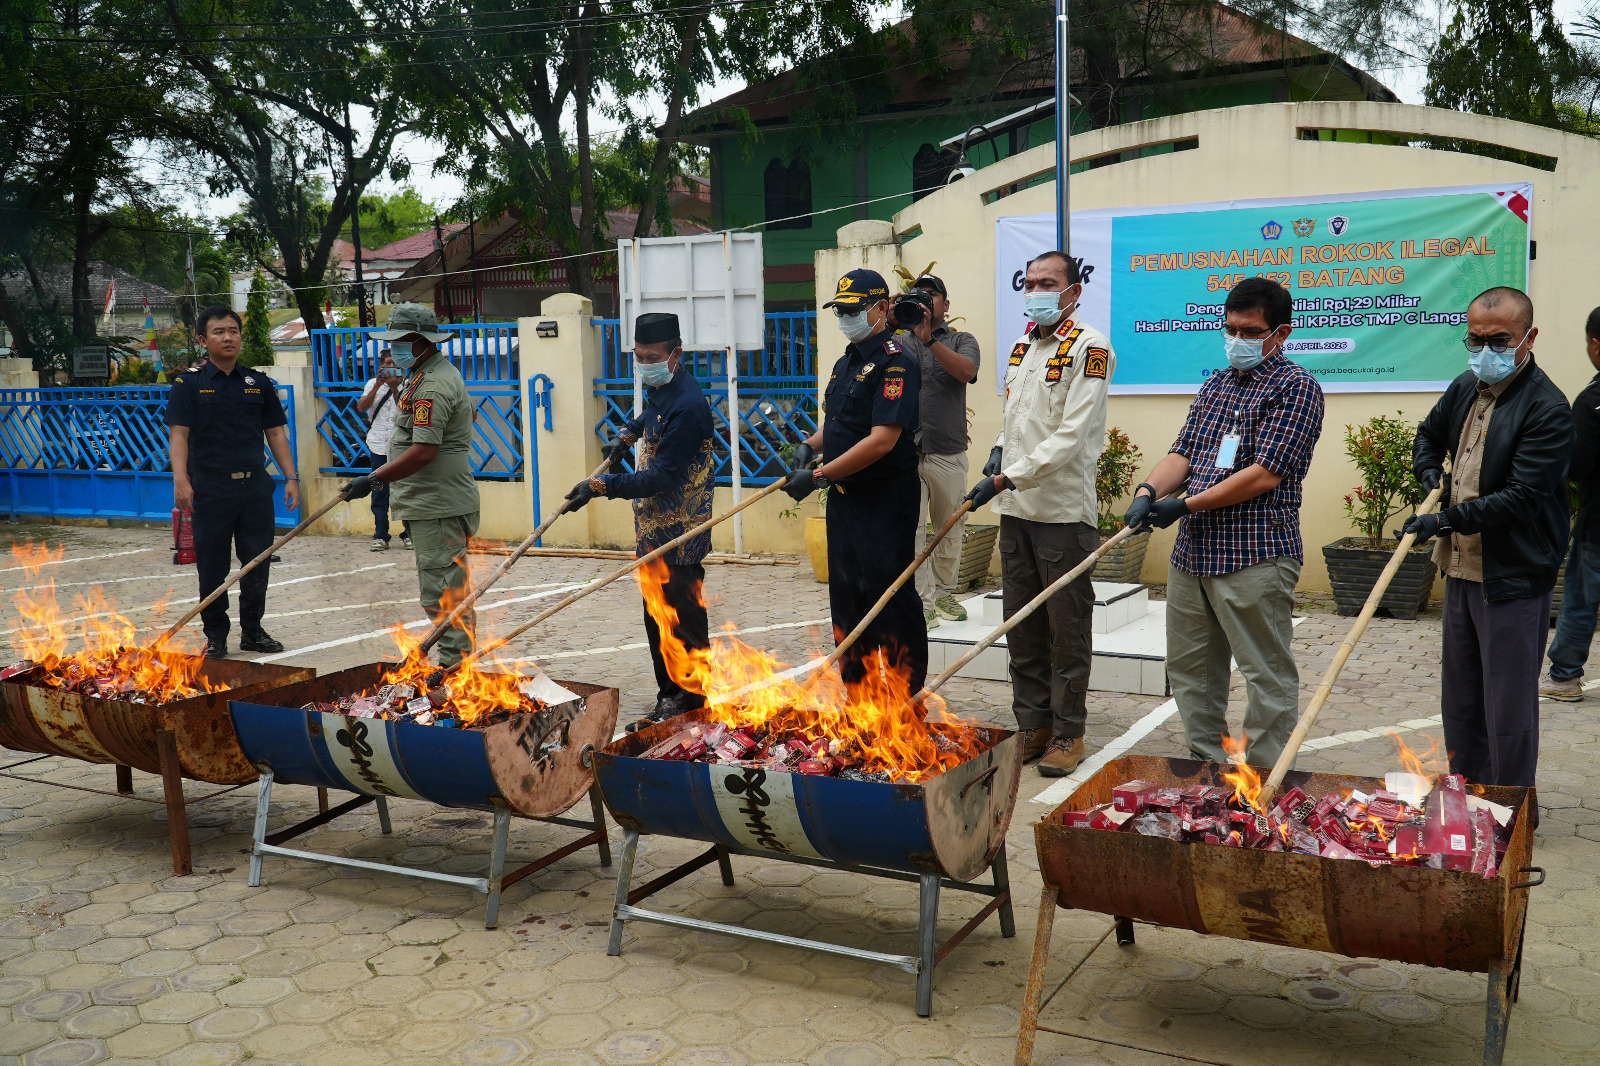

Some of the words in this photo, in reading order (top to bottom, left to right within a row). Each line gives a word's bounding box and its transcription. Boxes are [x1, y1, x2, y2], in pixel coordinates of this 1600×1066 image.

[1130, 246, 1293, 272] PEMUSNAHAN
[1300, 240, 1395, 265] ROKOK
[1400, 236, 1496, 260] ILEGAL
[1298, 266, 1405, 289] BATANG
[1186, 303, 1226, 317] Deng
[1323, 296, 1373, 313] Rp1,29
[1376, 294, 1421, 309] Miliar
[1135, 319, 1169, 333] Hasil
[1306, 314, 1364, 329] KPPBC
[1365, 313, 1402, 327] TMP
[1404, 312, 1418, 325] C
[1420, 311, 1468, 327] Langs
[1287, 342, 1294, 351] 9
[1294, 342, 1323, 351] APRIL
[1323, 341, 1348, 350] 2026
[1060, 357, 1072, 365] PP
